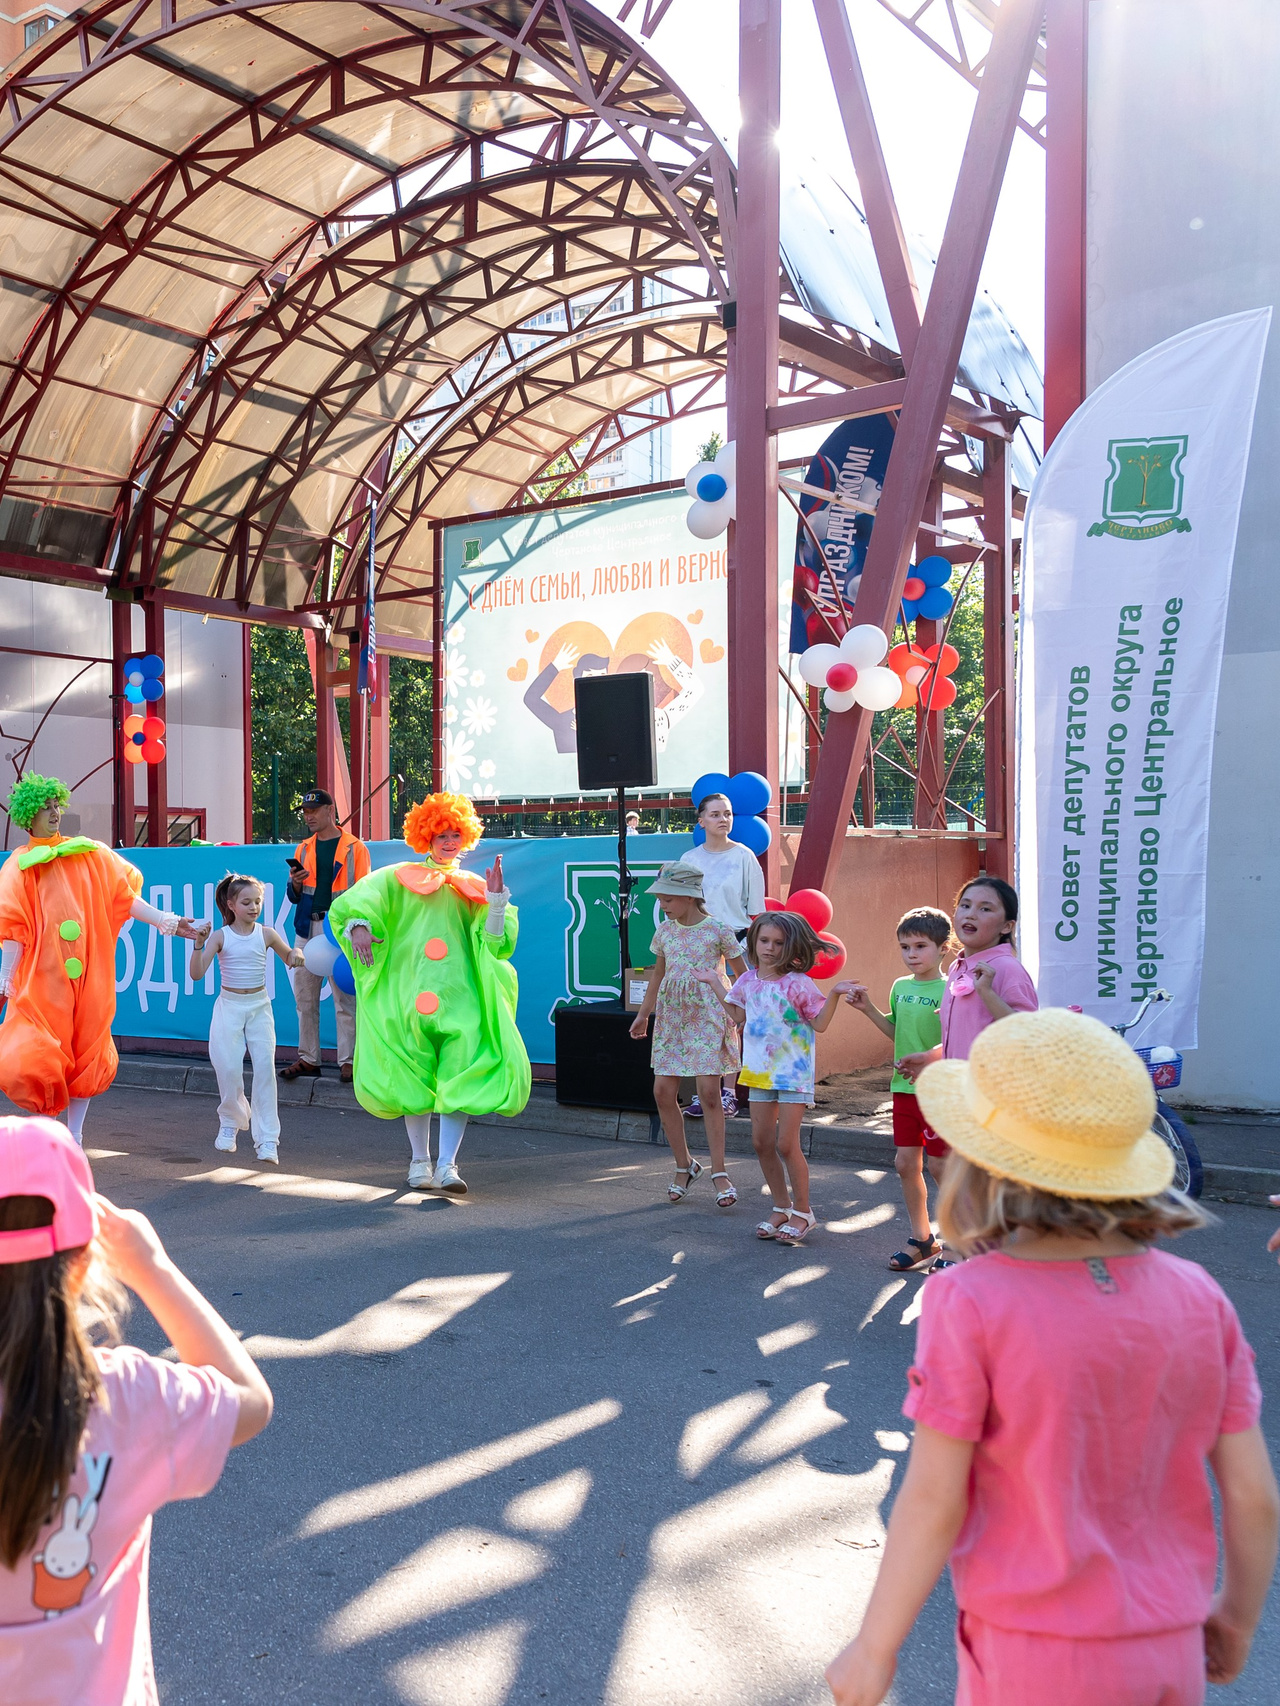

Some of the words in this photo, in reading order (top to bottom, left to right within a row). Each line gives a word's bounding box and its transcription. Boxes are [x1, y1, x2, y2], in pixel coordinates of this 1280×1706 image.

[469, 584, 477, 610] С
[481, 576, 524, 613] ДНЁМ
[530, 570, 586, 602] СЕМЬИ,
[590, 561, 652, 596] ЛЮБВИ
[659, 558, 670, 587] И
[677, 549, 728, 585] ВЕРНО
[1111, 603, 1145, 712] округа
[1063, 665, 1091, 836] депутатов
[1133, 597, 1184, 817] Центральное
[1055, 845, 1081, 942] Совет
[1097, 723, 1128, 997] муниципального
[1130, 827, 1165, 1002] Чертаново
